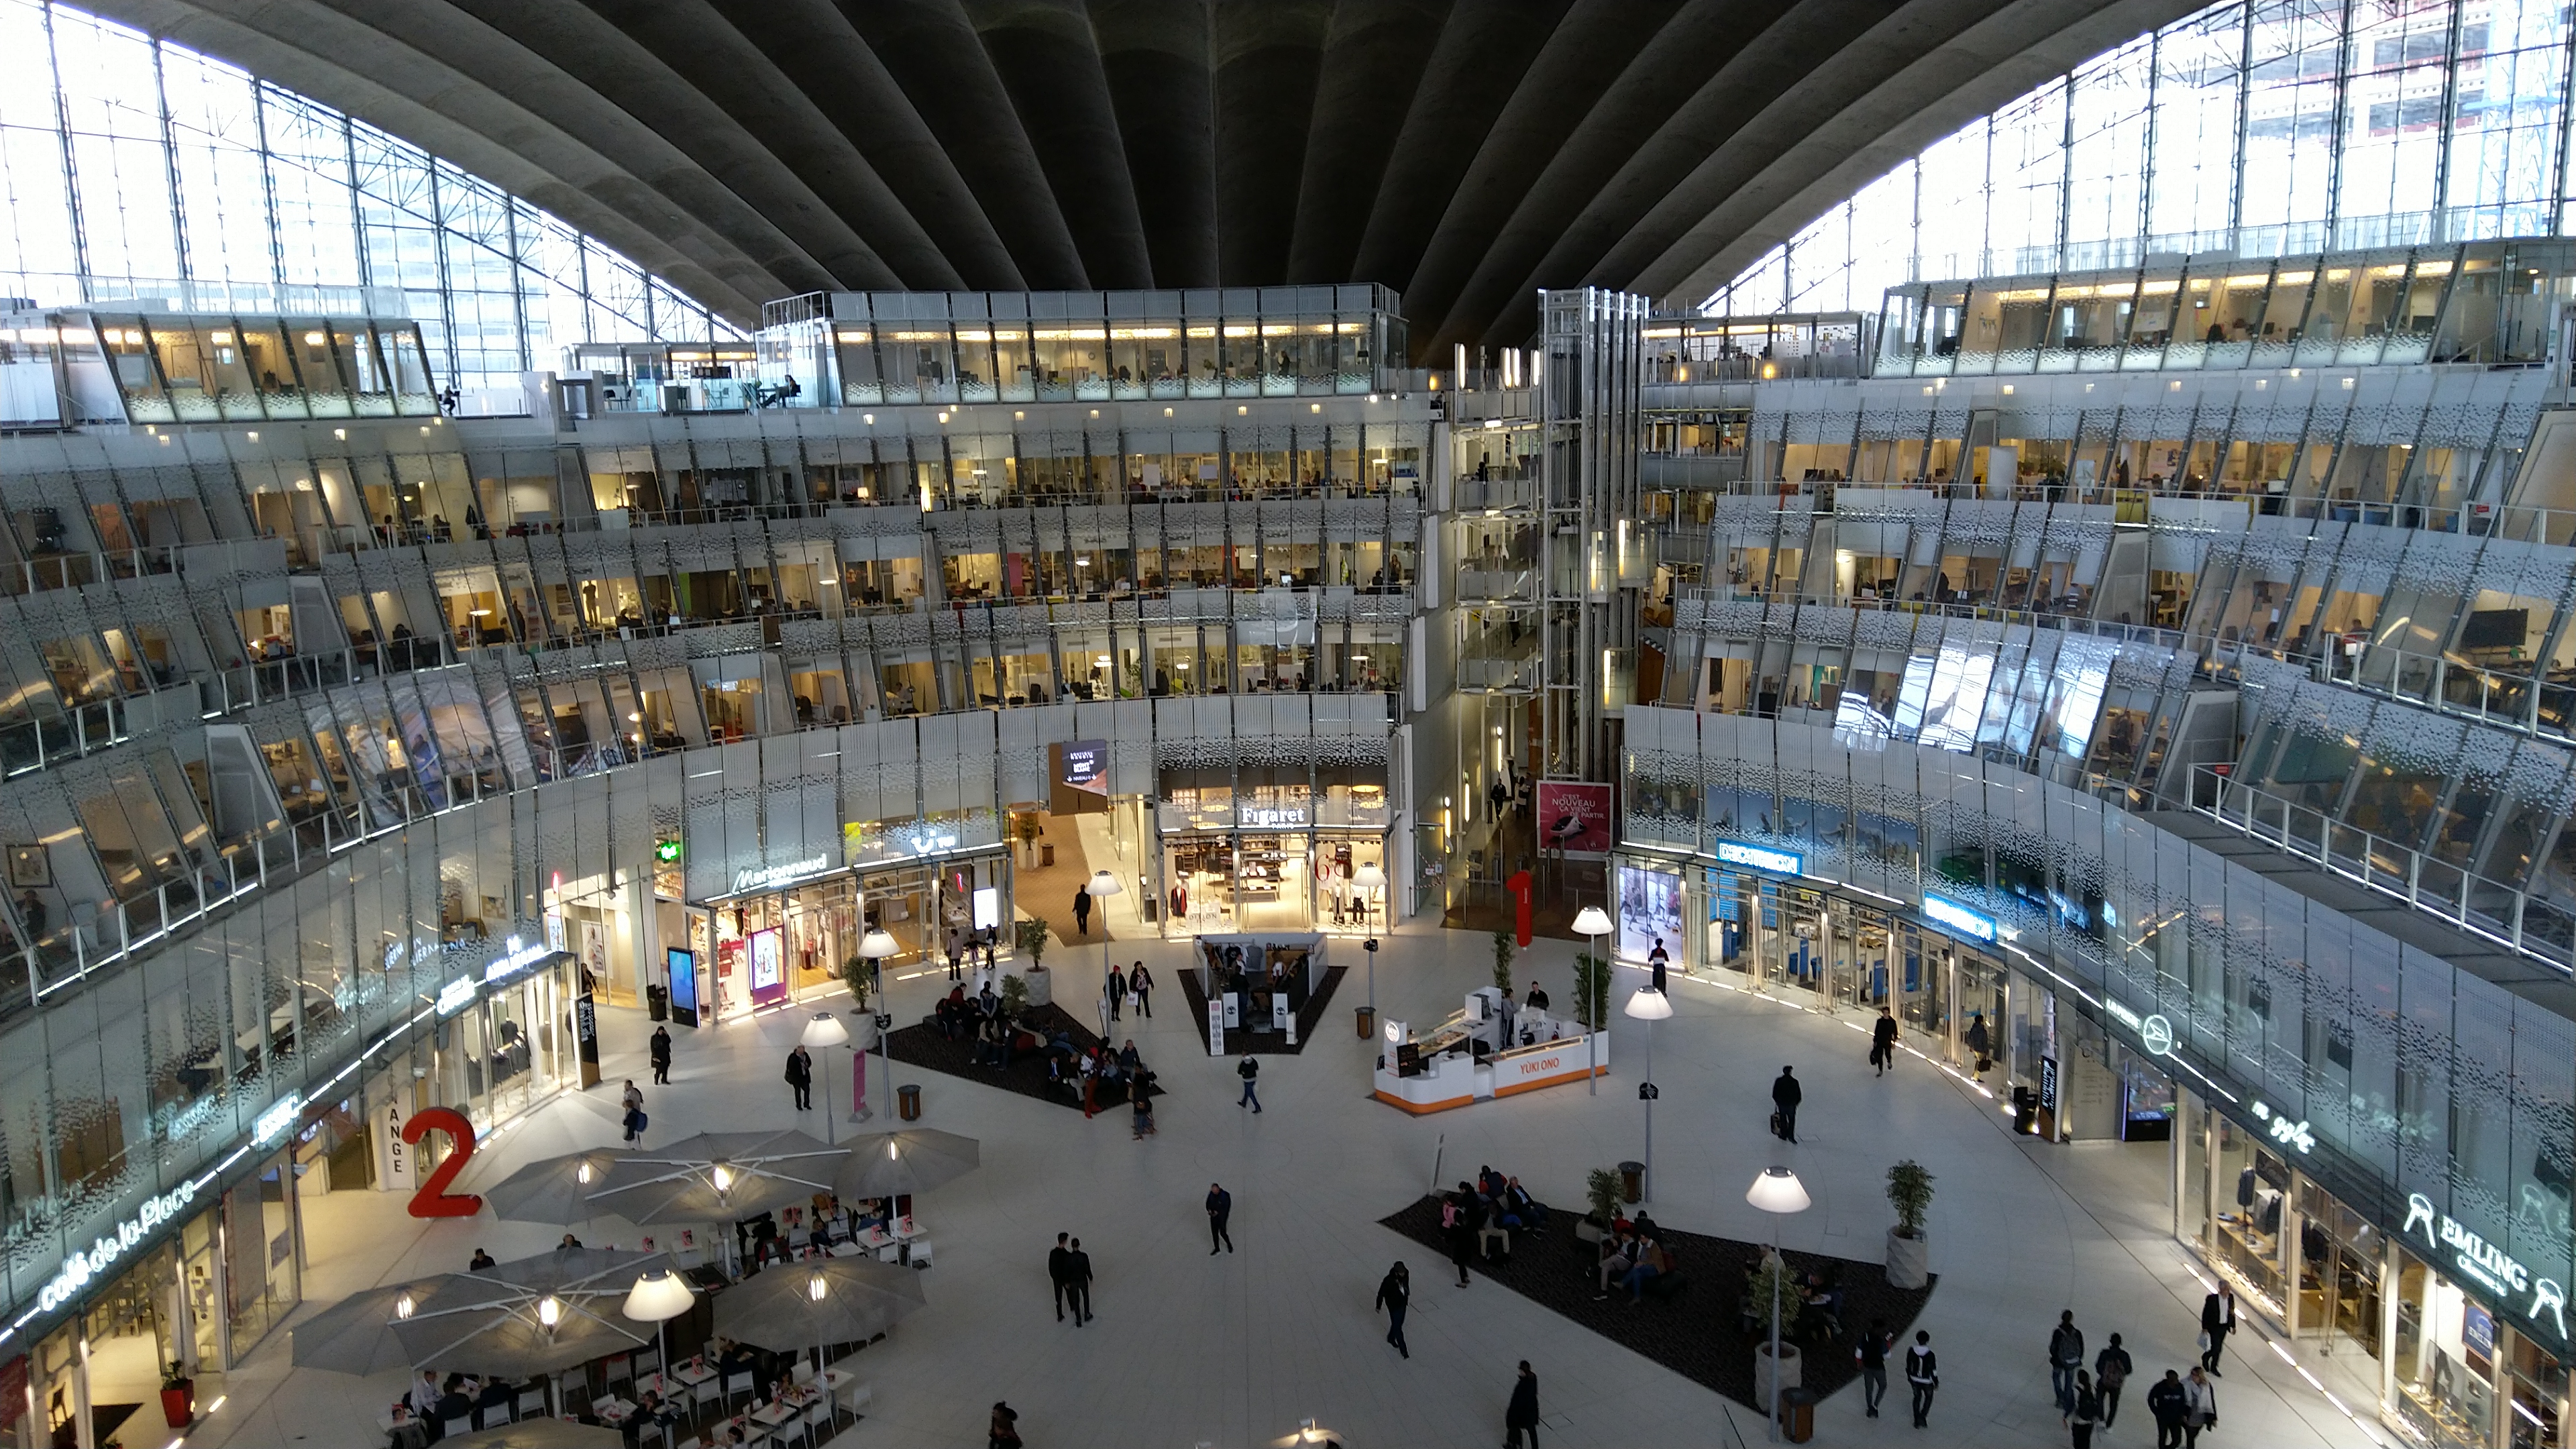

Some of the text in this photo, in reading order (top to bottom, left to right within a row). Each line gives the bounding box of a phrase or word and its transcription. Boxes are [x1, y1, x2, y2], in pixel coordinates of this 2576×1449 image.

[1242, 808, 1304, 826] Figaret
[1552, 798, 1596, 807] NOUVEAU
[732, 853, 826, 894] Marionnaud
[1506, 870, 1532, 947] 1
[1541, 1058, 1560, 1070] ONO
[389, 1095, 402, 1173] ANGE
[402, 1106, 482, 1218] 2
[89, 1238, 117, 1272] de
[118, 1221, 140, 1251] la
[140, 1180, 195, 1234] Place
[2441, 1215, 2528, 1292] EMLING
